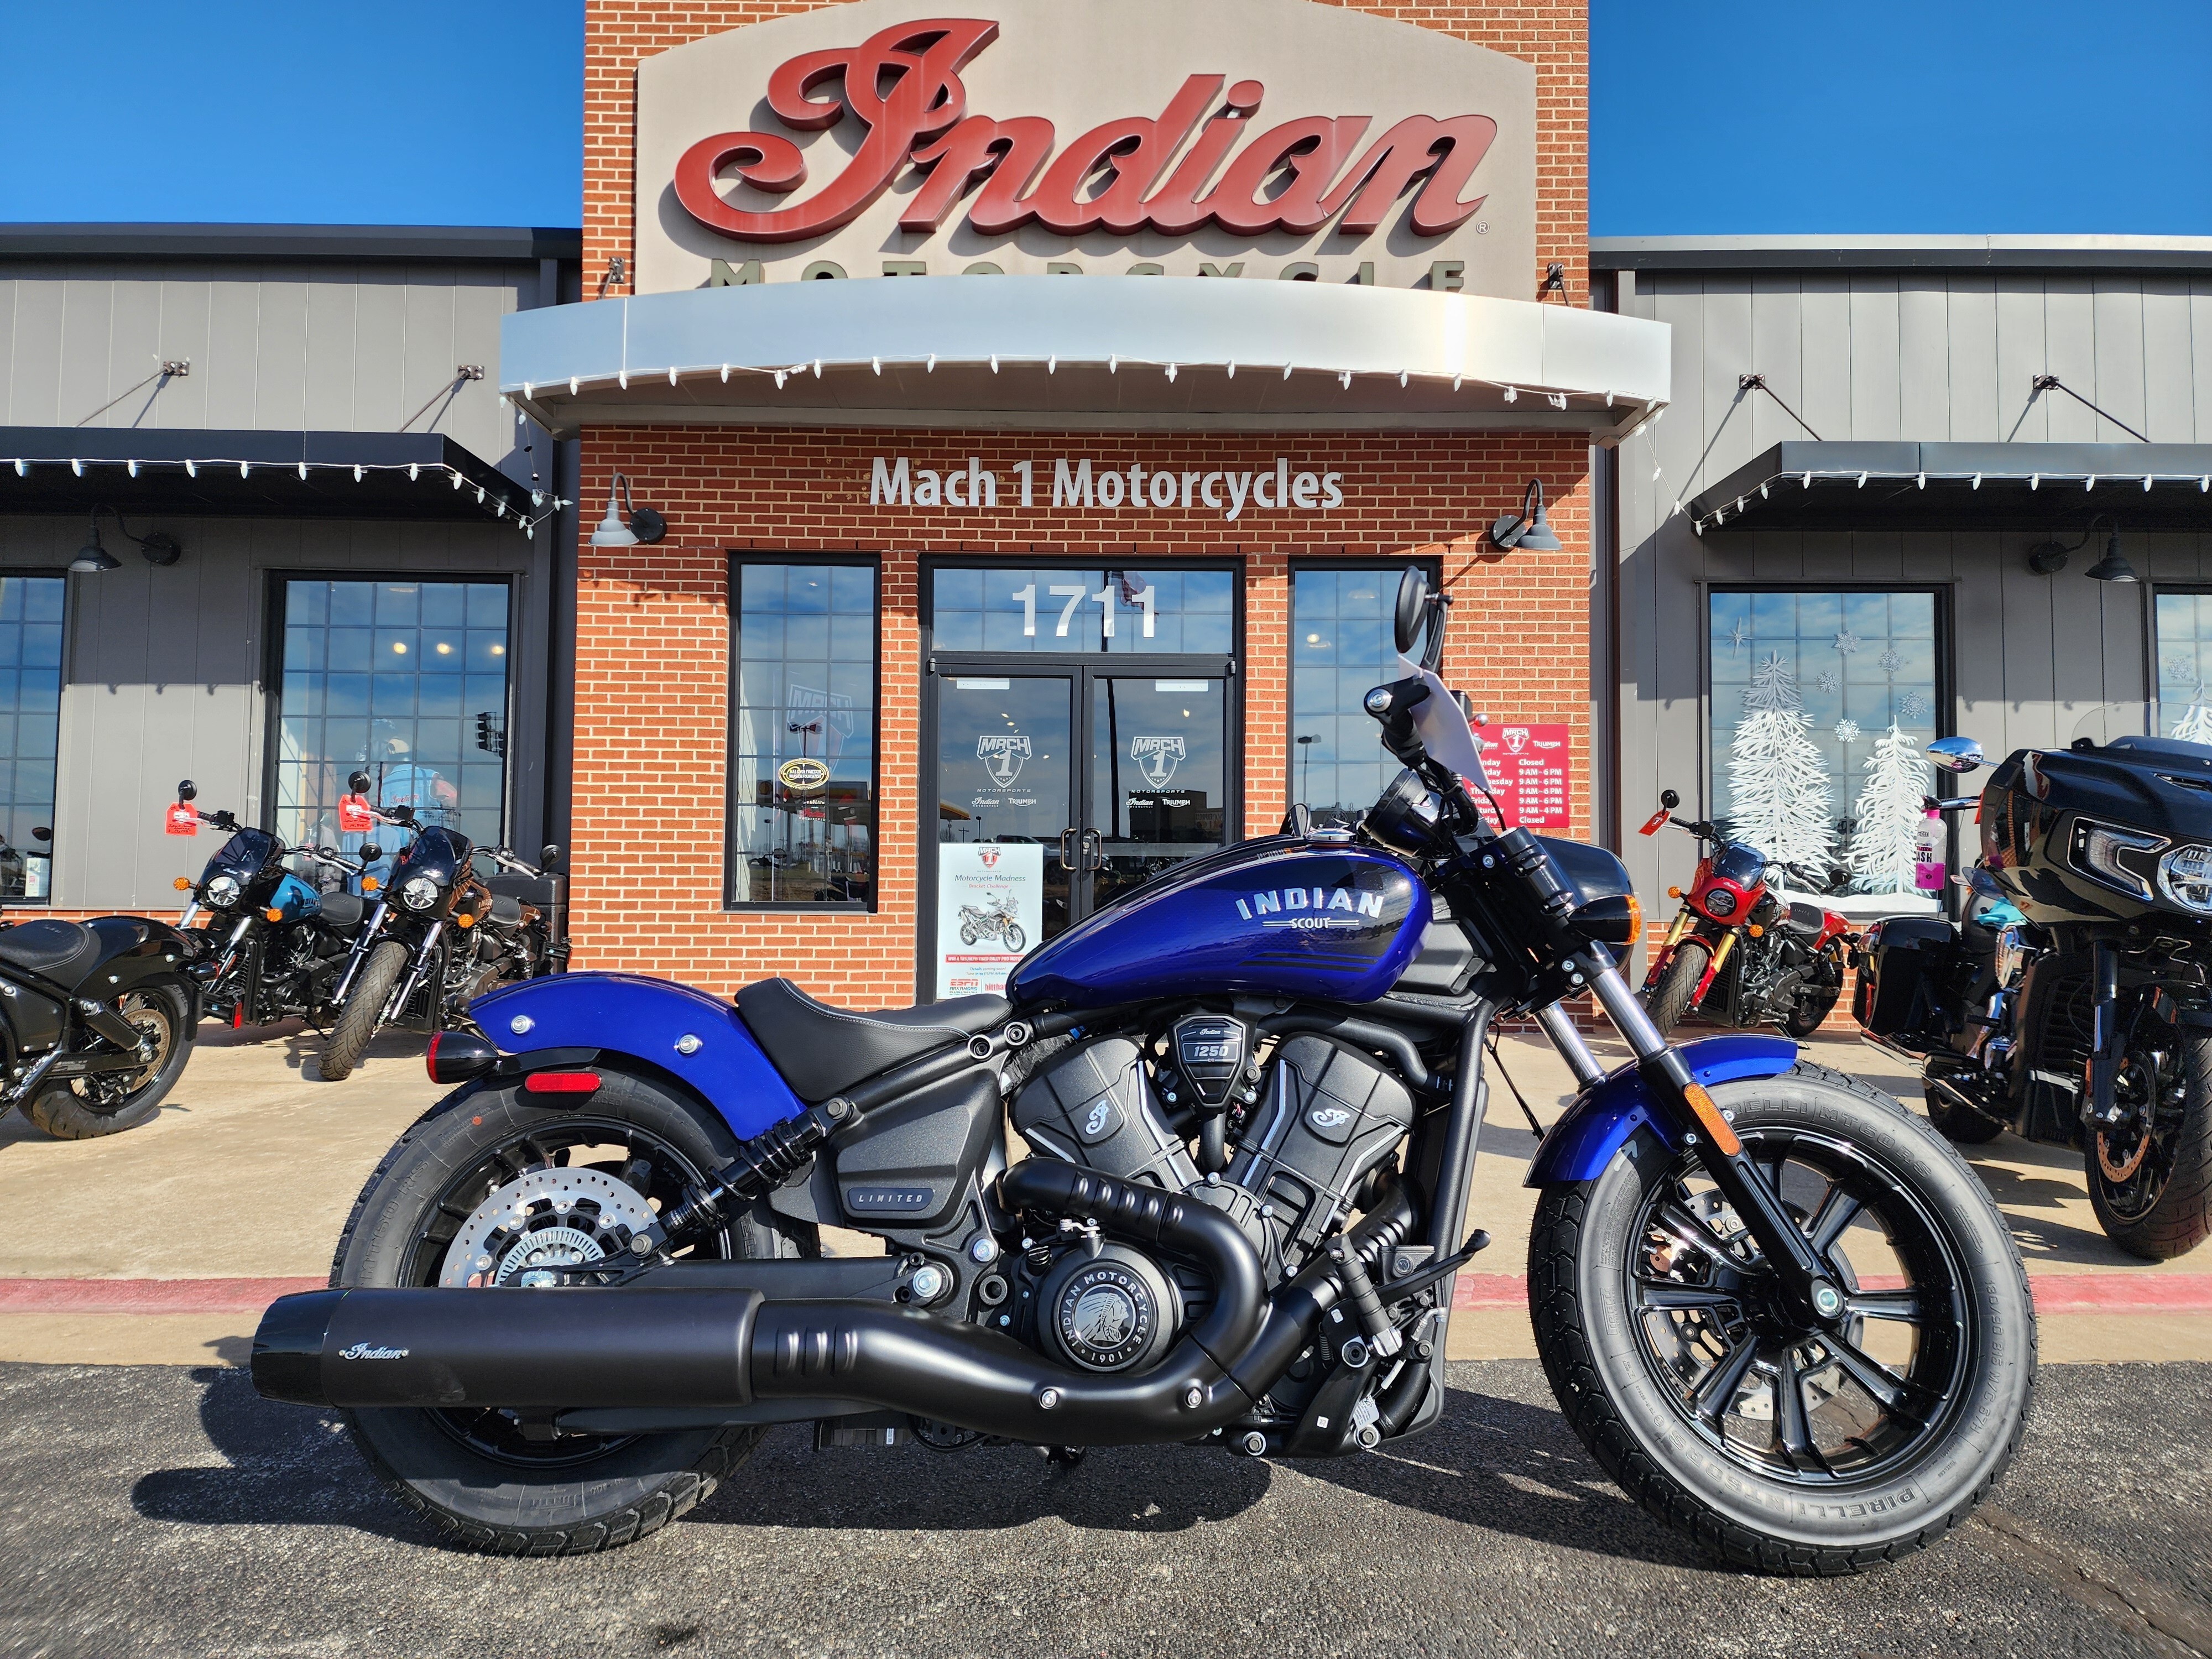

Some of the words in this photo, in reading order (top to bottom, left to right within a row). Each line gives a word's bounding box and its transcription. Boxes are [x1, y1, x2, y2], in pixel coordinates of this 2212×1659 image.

[674, 18, 1498, 244] Indian
[870, 457, 996, 508] Mach
[1013, 460, 1032, 508] 1
[1053, 457, 1343, 523] Motorcycles
[1013, 584, 1155, 638] 1711
[1504, 728, 1528, 737] MACH
[979, 738, 1029, 755] MACH
[1134, 739, 1183, 756] MACH
[1532, 740, 1561, 749] TRIUMPH
[1481, 758, 1501, 768] nday
[1484, 768, 1501, 777] sday
[1488, 778, 1514, 786] nesday
[1470, 787, 1505, 796] Thuday
[1008, 797, 1036, 807] TRIUMPH
[1125, 797, 1154, 806] Indian
[1162, 799, 1191, 807] TRIUMPH
[978, 847, 1001, 855] MACH
[1917, 852, 1932, 863] ASH
[954, 874, 993, 883] Motorcycle
[1235, 887, 1385, 920] INDIAN
[1291, 917, 1331, 929] SCOUT
[1194, 1046, 1229, 1057] 1250
[1725, 1099, 1808, 1116] RELLI
[858, 1194, 923, 1203] LIMITED
[1062, 1285, 1082, 1347] INDIAN
[1083, 1271, 1148, 1345] MOTORCYCLE
[344, 1342, 404, 1360] Indian
[1091, 1350, 1124, 1363] 1901
[1798, 1485, 1917, 1519] PIRELLI
